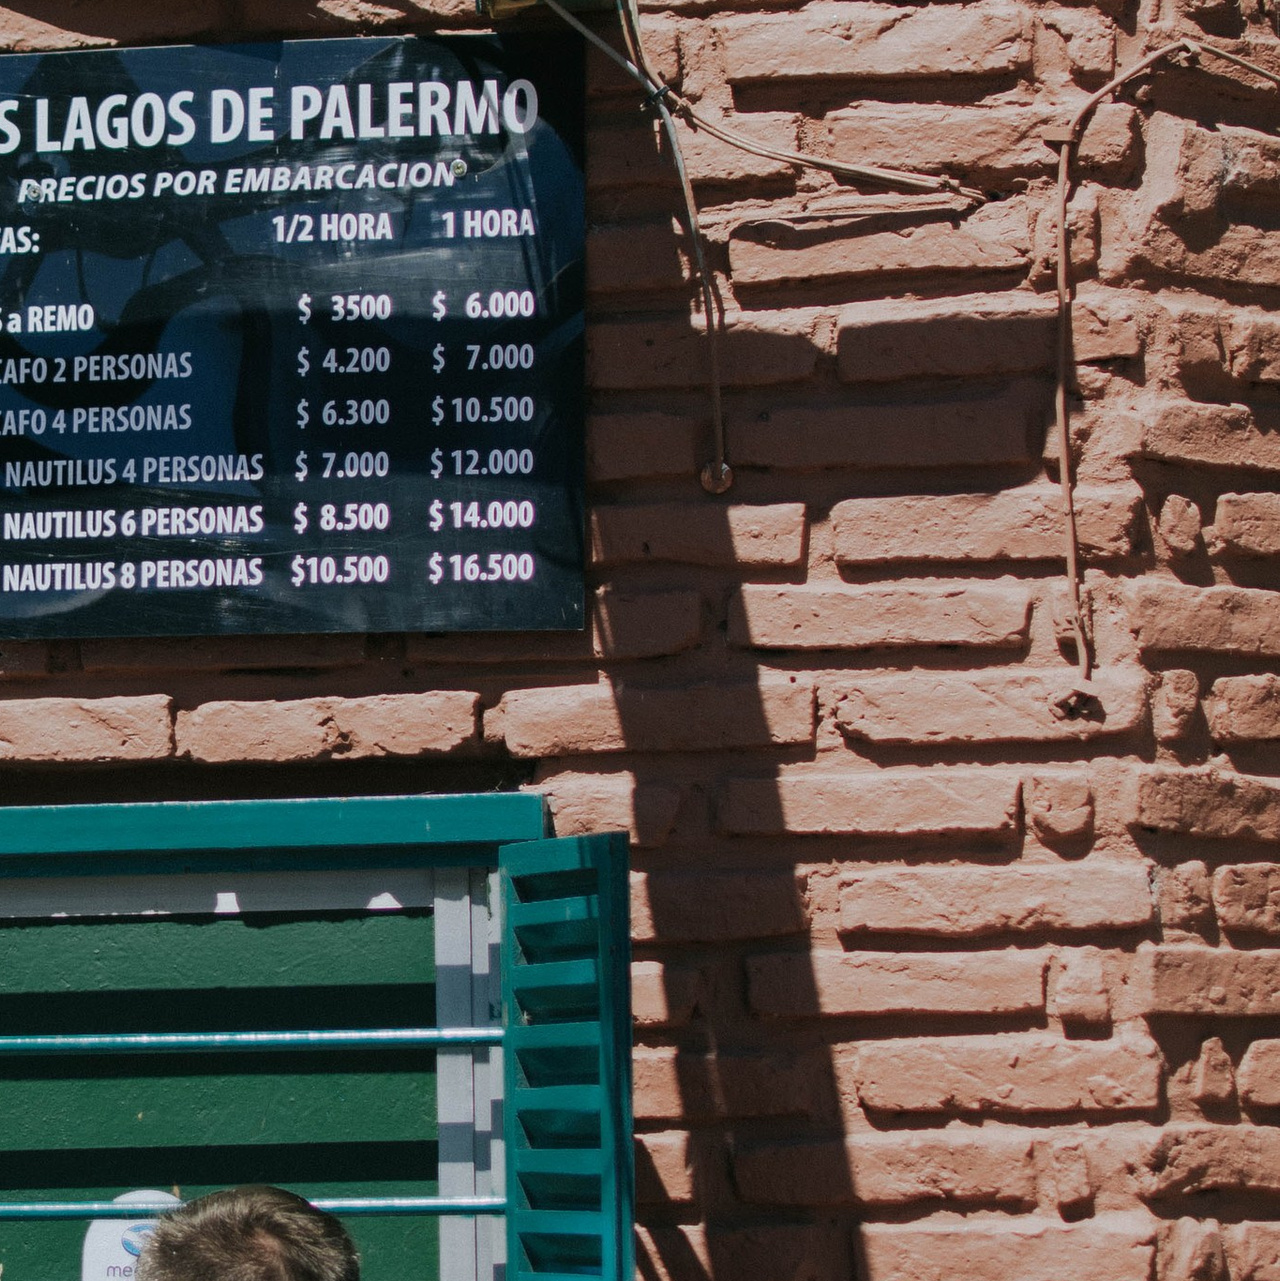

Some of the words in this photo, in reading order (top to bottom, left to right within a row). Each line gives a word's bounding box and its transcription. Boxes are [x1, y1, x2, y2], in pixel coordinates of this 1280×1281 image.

[35, 90, 196, 152] LAGOS
[211, 87, 274, 144] DE
[291, 78, 538, 140] PALERMO
[18, 173, 147, 203] PRECIOS
[153, 170, 217, 198] POR
[224, 162, 457, 194] EMBARCACION
[272, 214, 314, 244] 1/2
[321, 212, 393, 241] HORA
[441, 212, 455, 239] 1
[464, 209, 535, 238] HORA
[6, 311, 21, 334] a
[27, 304, 95, 333] REMO
[297, 293, 312, 324] $
[331, 294, 391, 321] 3500
[432, 290, 446, 321] $
[466, 291, 535, 318] 6.000
[53, 357, 67, 383] 2
[73, 352, 193, 382] PERSONAS
[297, 346, 310, 377] $
[322, 347, 391, 373] 4.200
[432, 343, 445, 374] $
[466, 343, 534, 370] 7.000
[51, 409, 67, 434] 4
[72, 404, 192, 433] PERSONAS
[296, 398, 310, 429] $
[322, 399, 390, 425] 6.300
[431, 395, 445, 426] $
[452, 396, 534, 422] 10.500
[5, 458, 117, 487] NAUTILUS
[122, 458, 137, 483] 4
[143, 453, 264, 483] PERSONAS
[295, 450, 308, 482] $
[322, 451, 389, 478] 7.000
[430, 447, 443, 478] $
[451, 448, 534, 475] 12.000
[3, 509, 117, 540] NAUTILUS
[120, 509, 136, 537] 6
[141, 505, 264, 536] PERSONAS
[294, 502, 308, 535] $
[320, 503, 390, 531] 8.500
[429, 499, 443, 532] $
[449, 500, 534, 529] 14.000
[2, 561, 116, 593] NAUTILUS
[120, 562, 136, 588] 8
[140, 557, 263, 588] PERSONAS
[428, 552, 443, 585] $
[449, 553, 534, 581] 16.500
